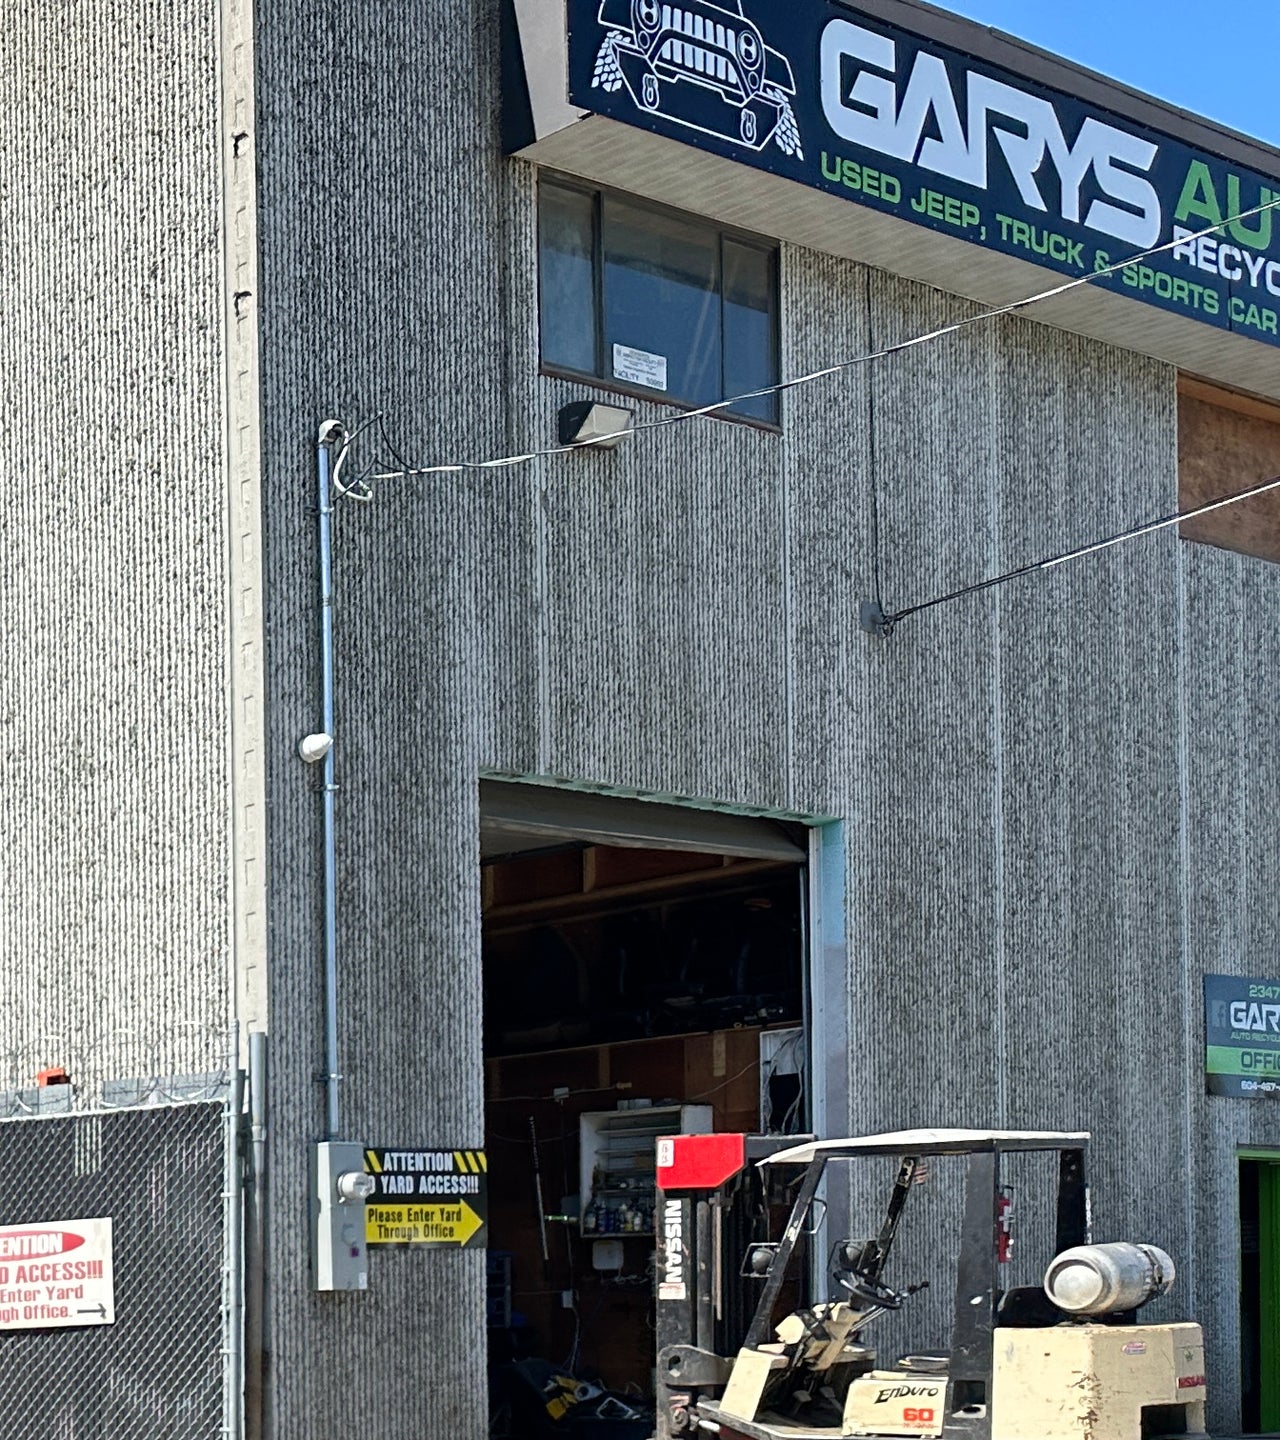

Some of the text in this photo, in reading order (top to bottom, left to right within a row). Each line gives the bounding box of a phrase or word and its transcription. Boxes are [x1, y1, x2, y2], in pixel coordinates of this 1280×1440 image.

[820, 18, 1280, 250] GARYS AU
[821, 151, 902, 204] USED
[910, 187, 987, 241] JEEP,
[995, 213, 1085, 269] TRUCK
[1093, 249, 1113, 278] &
[1121, 262, 1219, 315] SPORTS
[1241, 1050, 1280, 1070] OFFI
[383, 1151, 454, 1172] ATTENTION
[380, 1175, 415, 1194] YARD
[418, 1175, 479, 1194] ACCESS!!!
[367, 1207, 462, 1223] Please Enter Yard
[377, 1224, 455, 1241] Through Office
[664, 1199, 682, 1283] NISSAN
[14, 1259, 104, 1284] ACCESS!!!
[0, 1288, 41, 1304] Enter
[45, 1284, 84, 1301] Yard
[903, 1407, 934, 1422] 60
